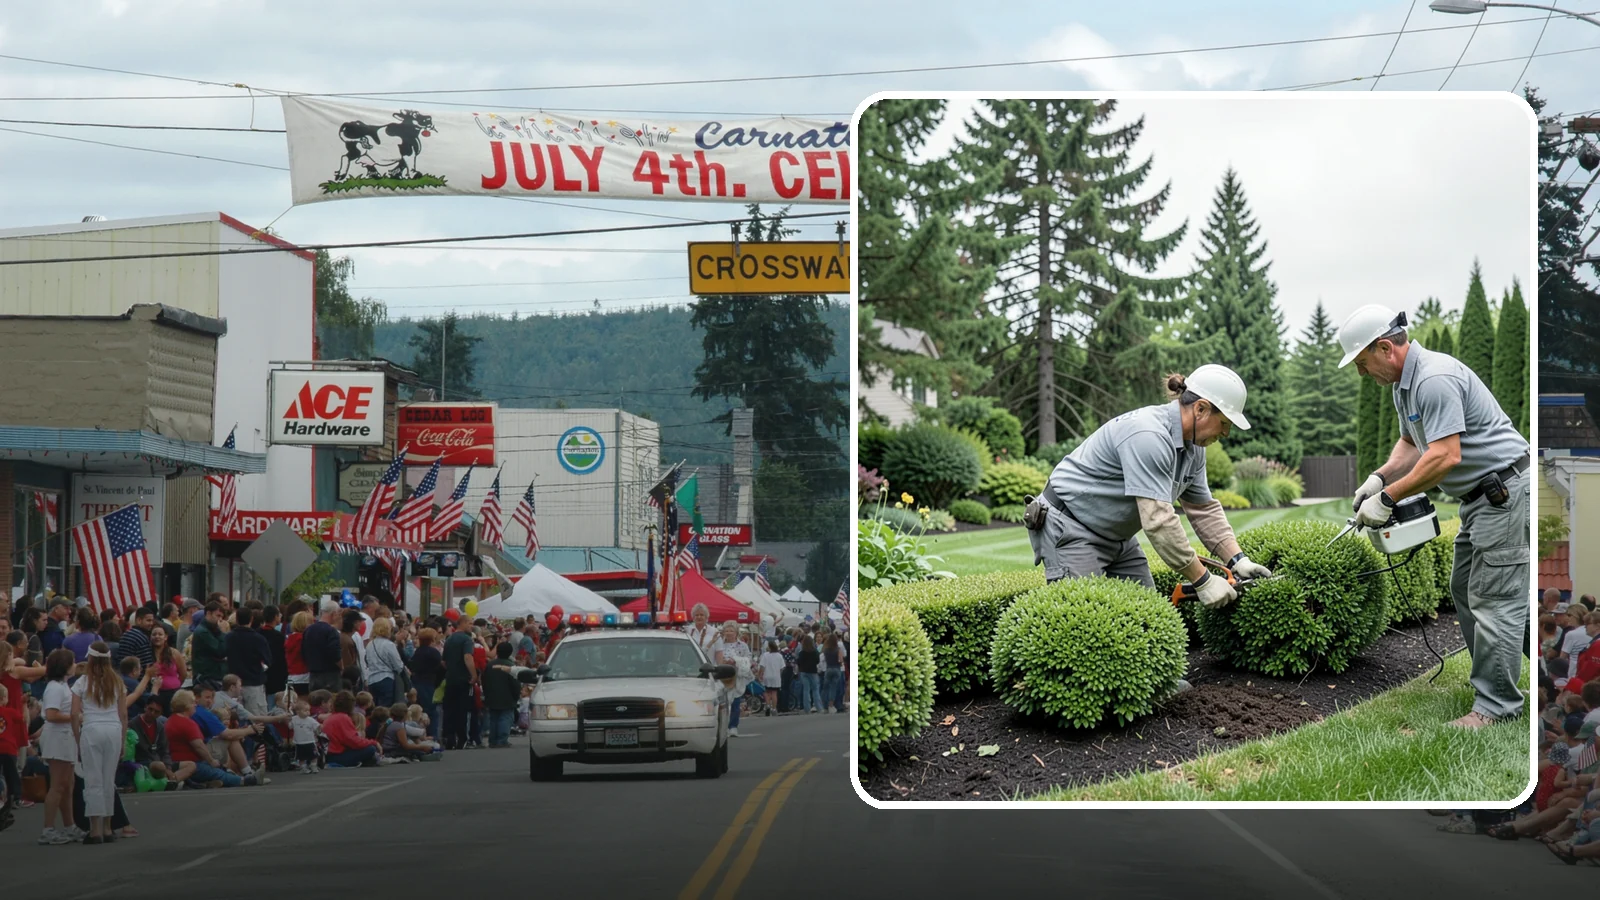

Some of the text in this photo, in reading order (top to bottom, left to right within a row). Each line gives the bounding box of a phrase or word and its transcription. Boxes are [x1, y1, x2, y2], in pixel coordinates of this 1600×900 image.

[481, 141, 605, 192] JULY
[632, 150, 746, 198] 4th.
[696, 253, 850, 280] CROSSWA
[282, 379, 374, 420] ACE
[406, 409, 485, 422] CEDAR LOG
[283, 421, 371, 437] Hardware
[416, 428, 477, 447] Coca-Cola
[353, 467, 385, 480] Simpl
[83, 484, 155, 496] St. Vincent de Paul
[81, 503, 154, 522] THT
[212, 515, 330, 536] HRDARE
[688, 526, 741, 535] CRNATION
[699, 535, 730, 543] GLASS
